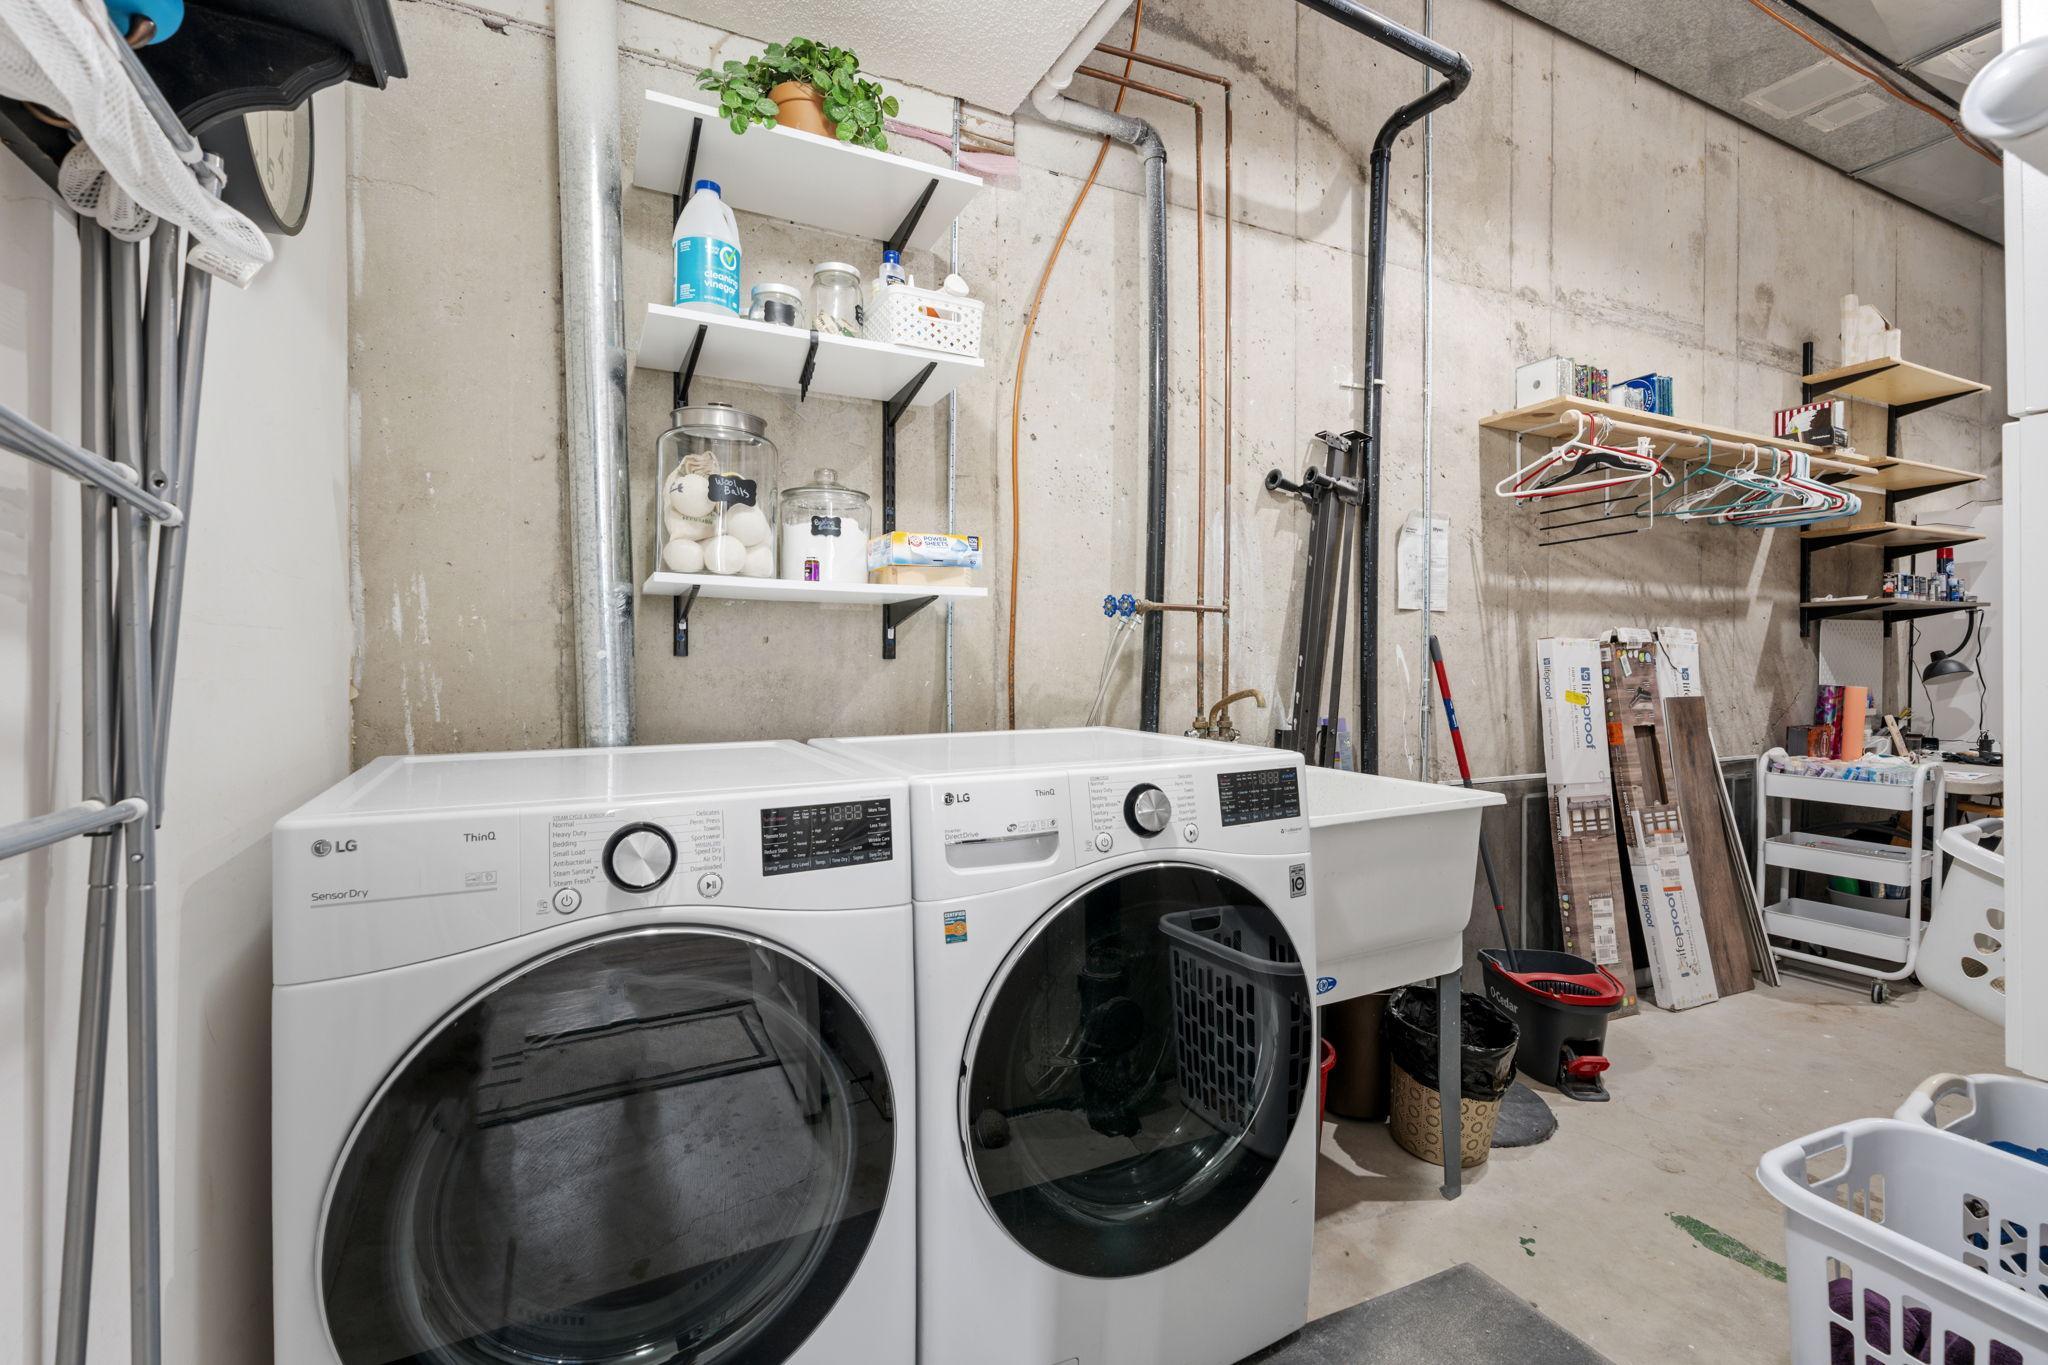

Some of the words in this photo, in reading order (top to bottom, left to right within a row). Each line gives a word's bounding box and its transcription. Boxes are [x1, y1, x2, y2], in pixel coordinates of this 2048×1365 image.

[266, 158, 276, 191] 5
[704, 270, 739, 290] cleaning
[704, 280, 737, 296] vinegar
[714, 477, 738, 488] Wool
[724, 486, 750, 499] Balls
[1543, 666, 1553, 700] lifeproof
[956, 793, 970, 803] LG
[1034, 788, 1055, 797] ThinQ
[463, 831, 497, 842] ThinQ
[335, 839, 358, 853] LG
[1641, 893, 1654, 928] lifeproof
